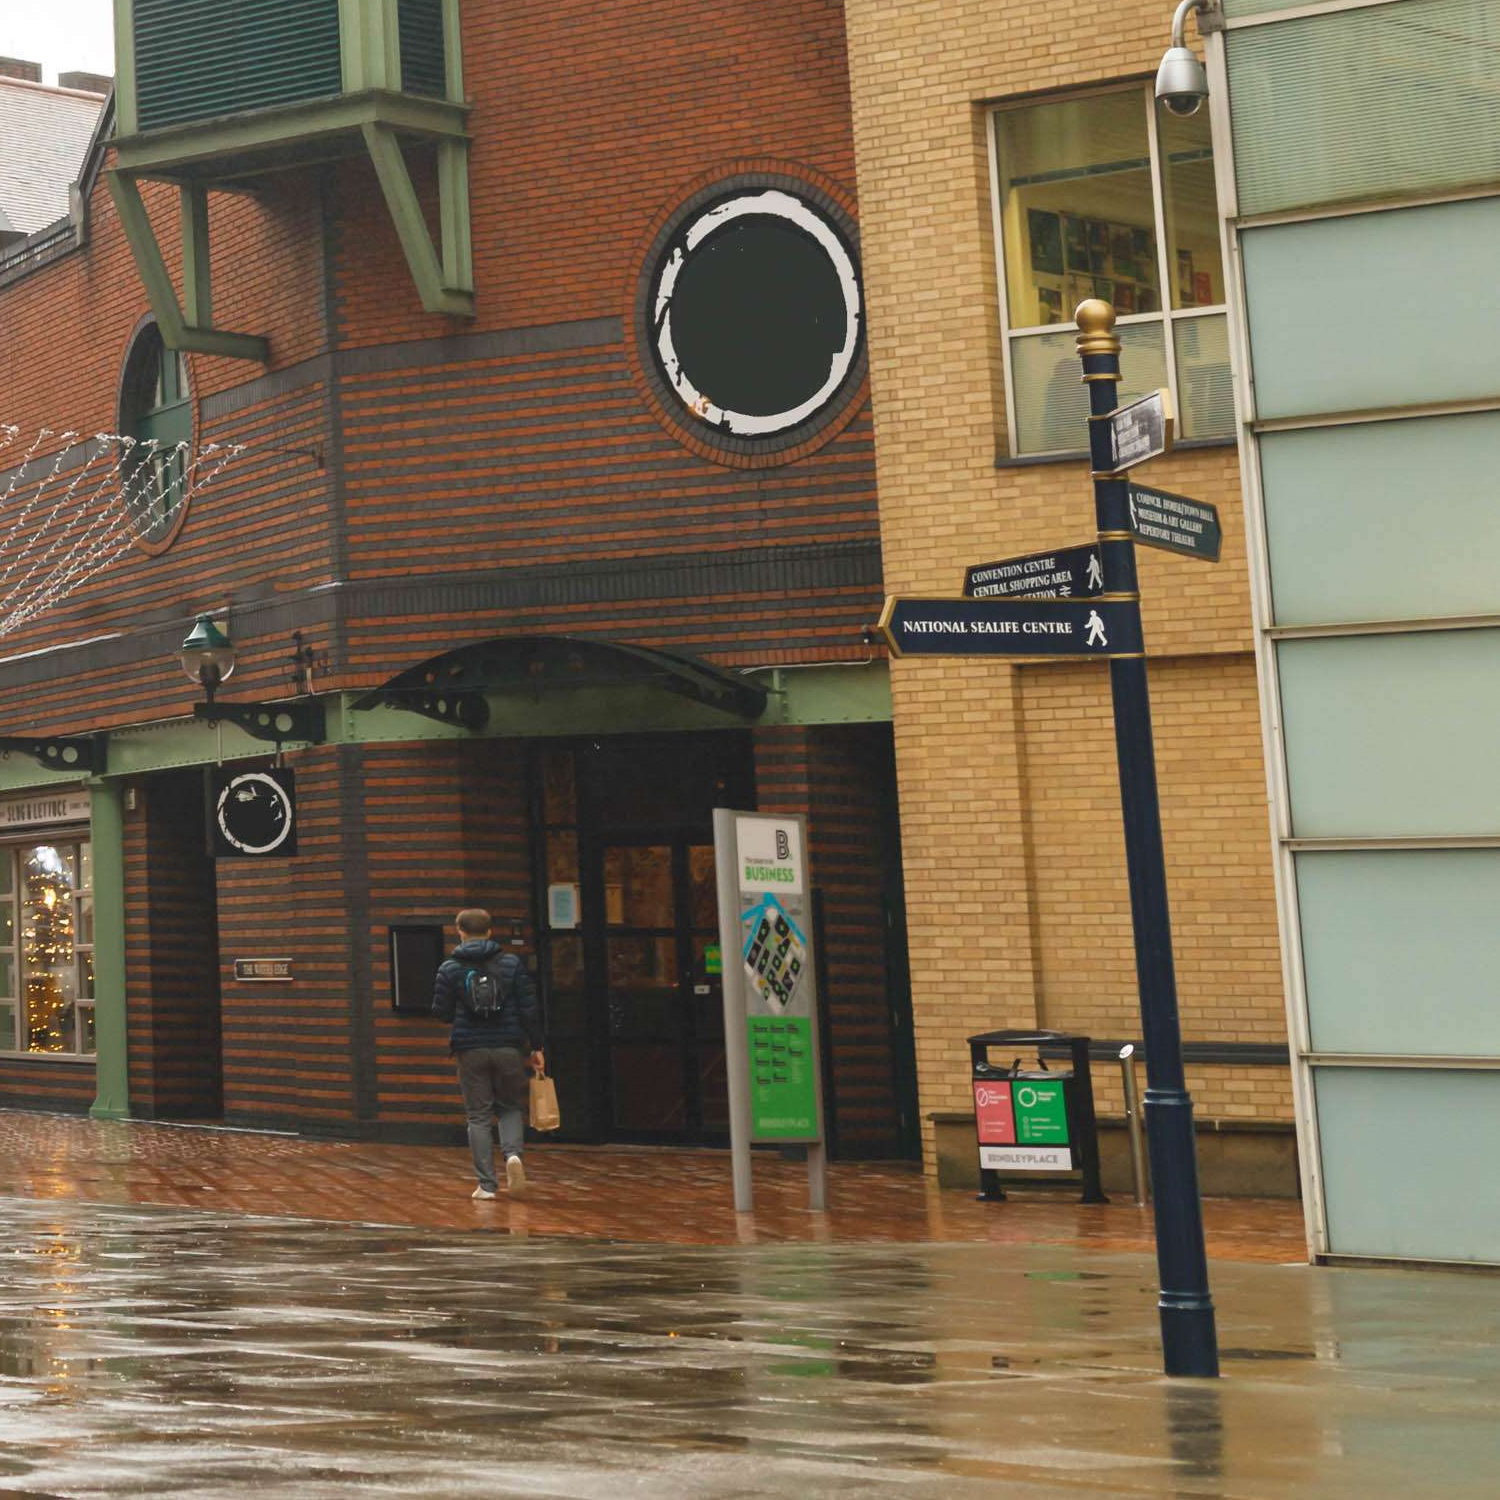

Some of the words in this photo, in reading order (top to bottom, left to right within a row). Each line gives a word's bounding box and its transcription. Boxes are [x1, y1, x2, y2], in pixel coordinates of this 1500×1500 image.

[971, 564, 1022, 583] CONVENTION
[1024, 557, 1056, 573] CENTRE
[973, 582, 1009, 598] CENTRAL
[1009, 574, 1050, 591] SHOPPING
[1050, 570, 1072, 584] AREA
[903, 620, 967, 633] NATIONAL
[971, 620, 1020, 634] SEALIFE
[1022, 621, 1073, 634] CENTRE
[744, 866, 795, 883] BUSINESS
